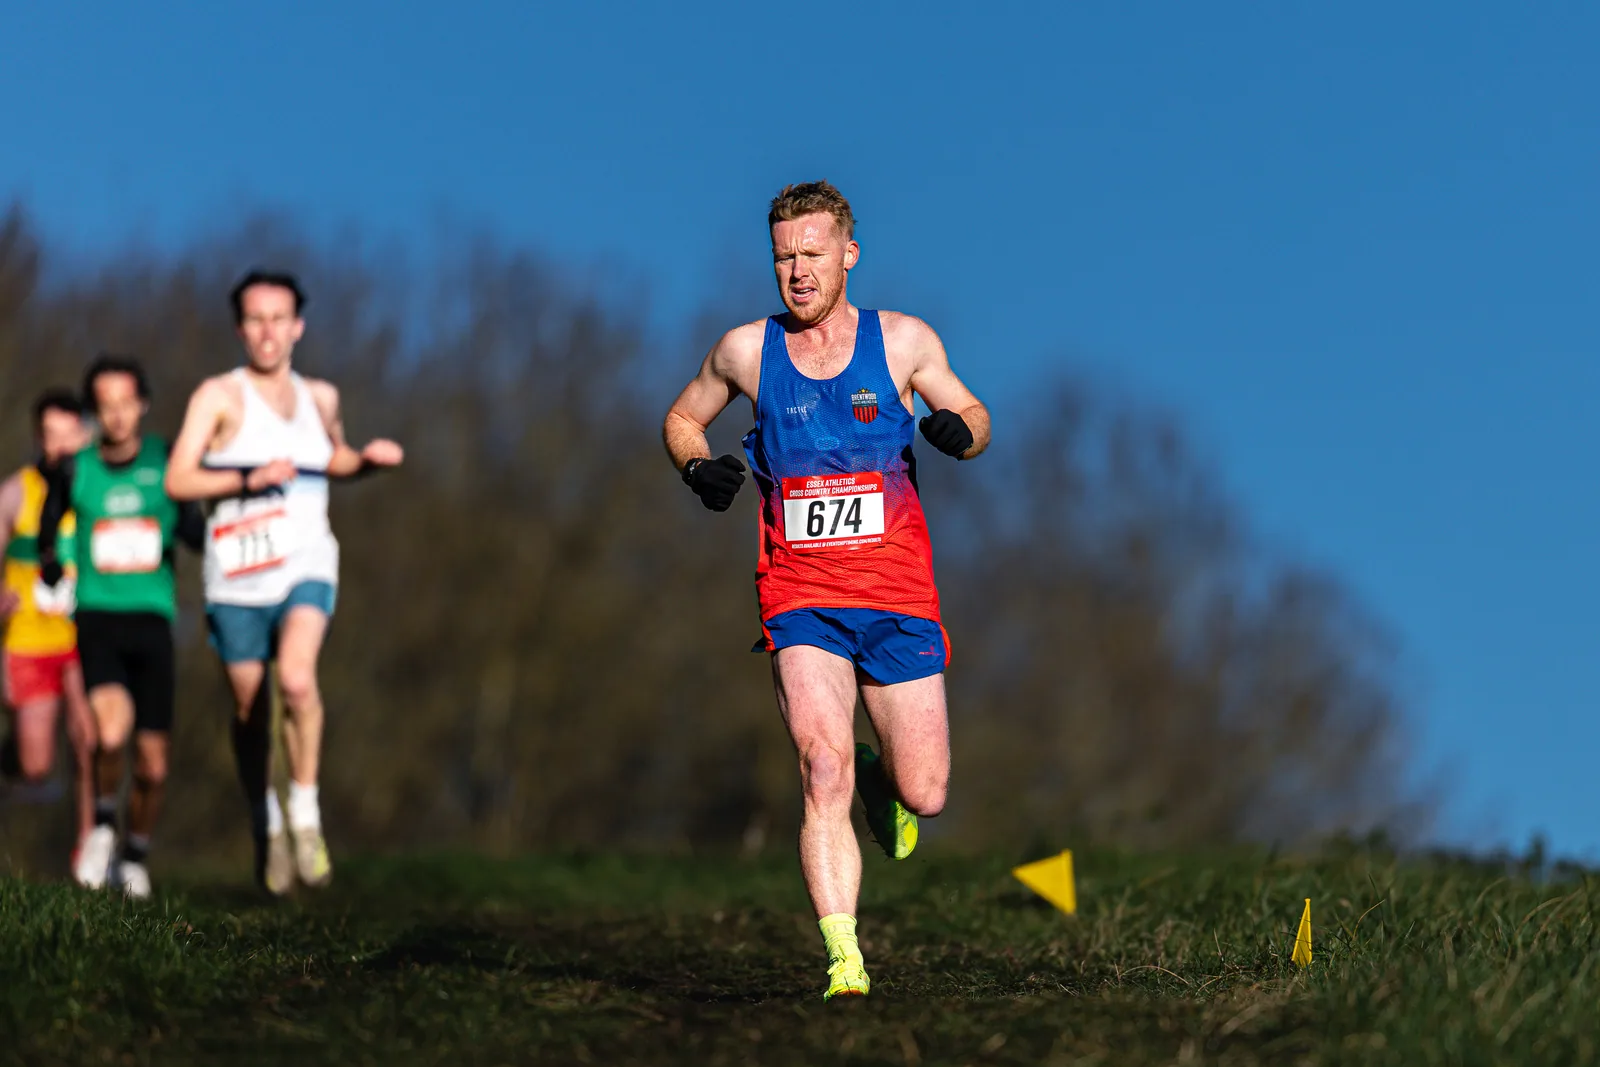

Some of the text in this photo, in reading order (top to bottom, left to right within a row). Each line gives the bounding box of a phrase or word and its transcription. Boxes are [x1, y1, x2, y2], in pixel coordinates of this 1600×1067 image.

[789, 483, 878, 497] CROSS COUNTRY CHAMPIONSHIPS
[806, 477, 856, 489] ESSEX ATHLETICS
[806, 497, 862, 538] 674
